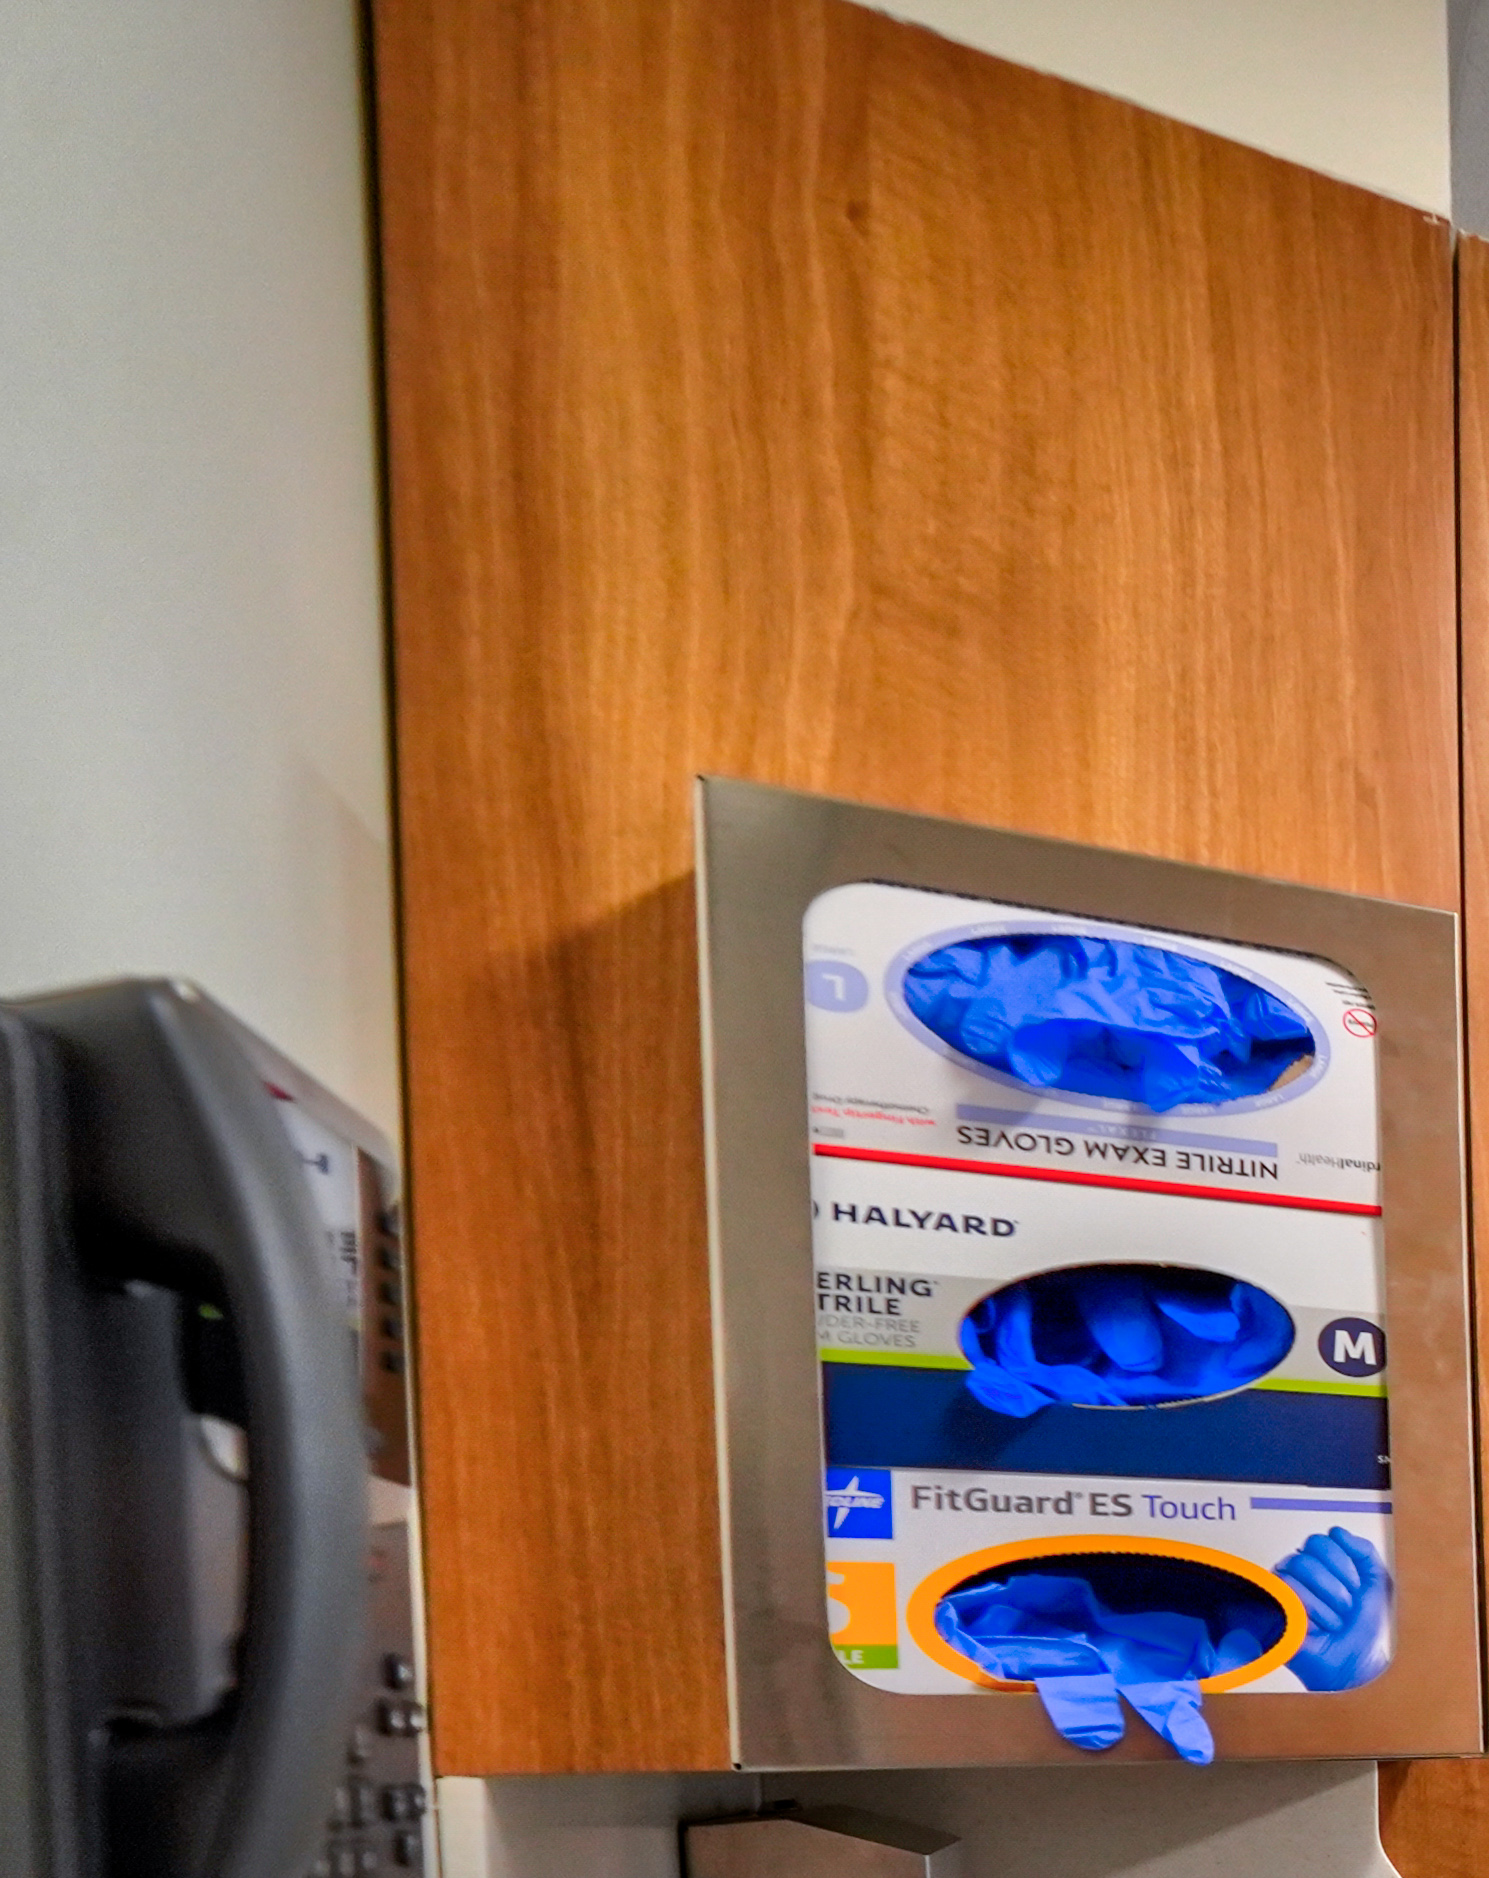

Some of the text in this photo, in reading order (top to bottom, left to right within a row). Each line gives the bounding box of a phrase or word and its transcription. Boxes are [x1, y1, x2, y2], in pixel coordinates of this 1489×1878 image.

[957, 1125, 1279, 1180] NITRILE EXAM GLOVES
[832, 1202, 1016, 1238] HALYARD
[1332, 1330, 1377, 1365] M
[1090, 1491, 1132, 1517] ES
[1146, 1494, 1237, 1522] Touch
